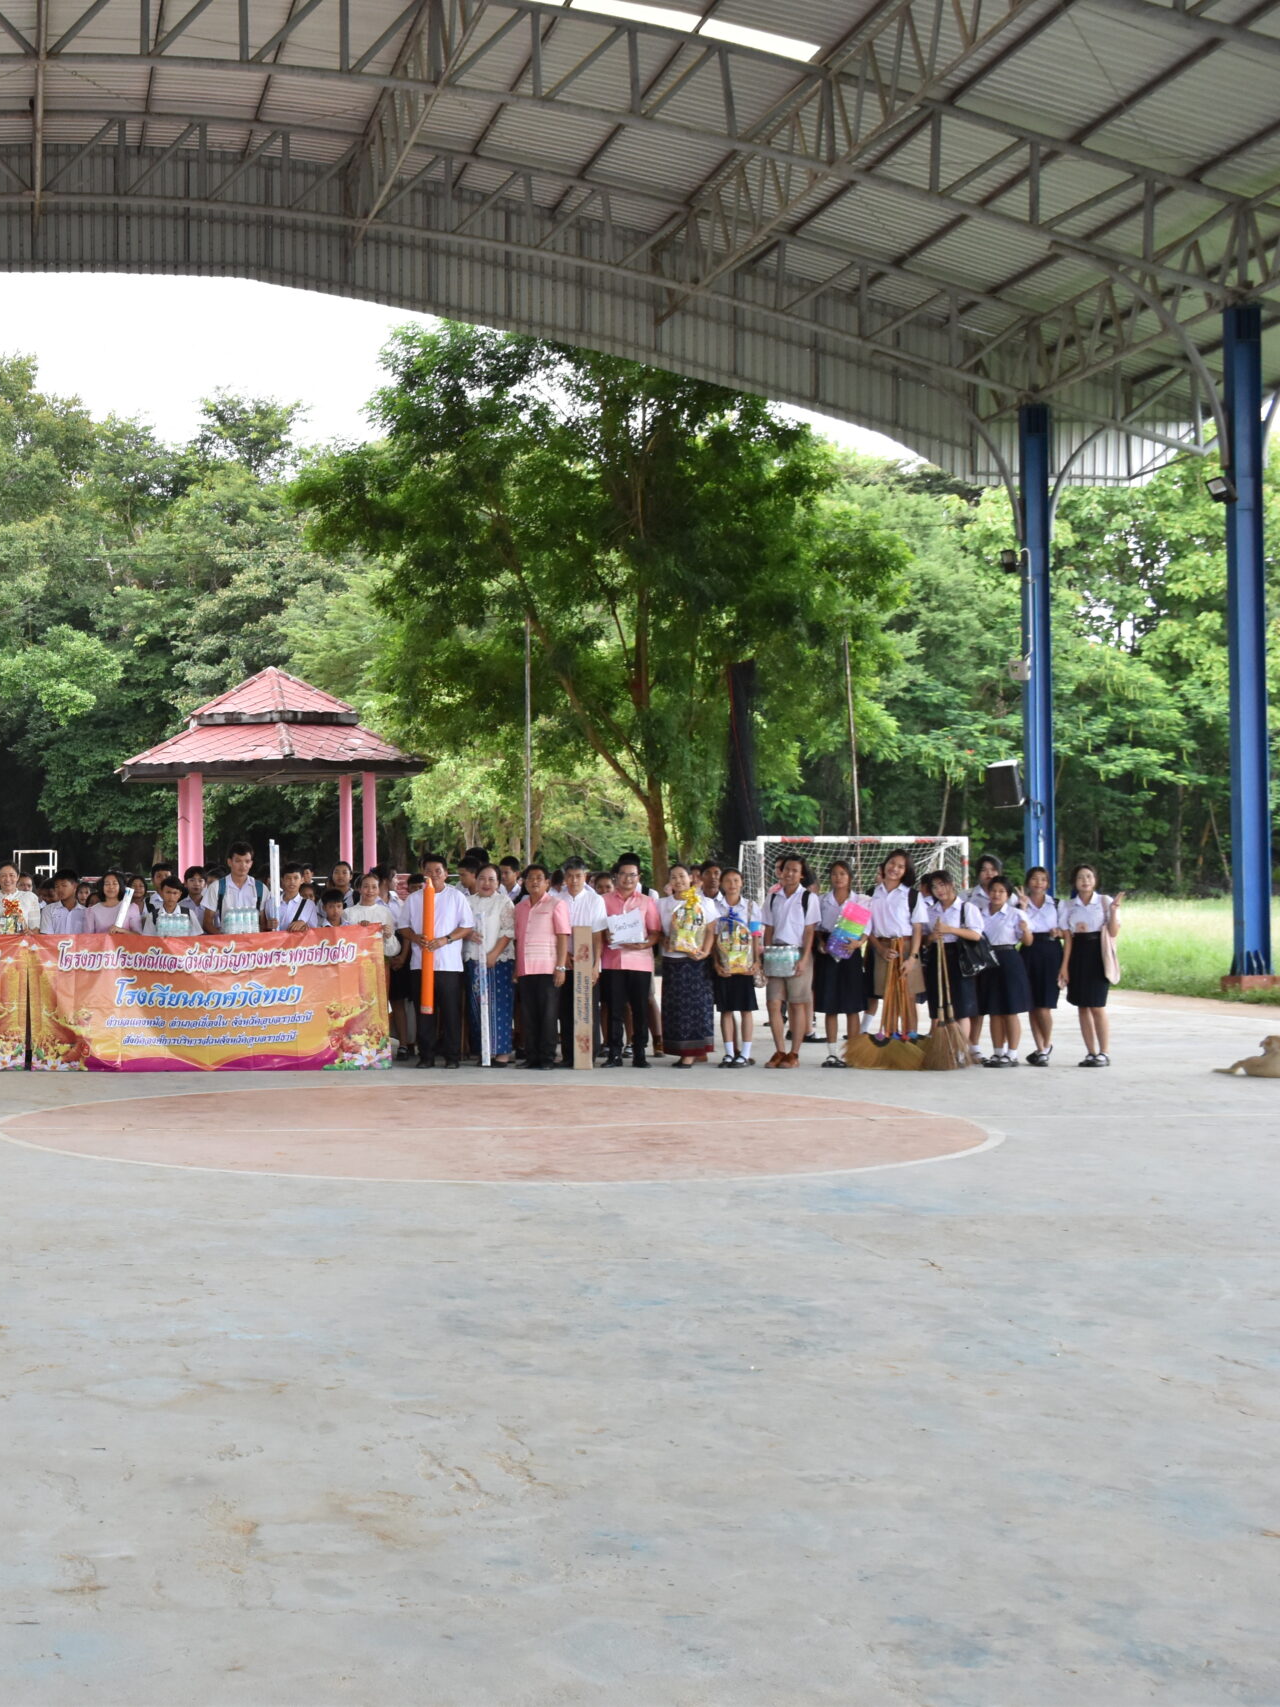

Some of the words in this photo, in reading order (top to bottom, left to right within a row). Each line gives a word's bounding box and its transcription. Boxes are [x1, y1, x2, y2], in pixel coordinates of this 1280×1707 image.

[58, 939, 357, 976] โครงการประเพณีและวันสำคัญทางพระพุทธศาสนา
[116, 977, 303, 1008] โรงเรียนนาคำวิทยา
